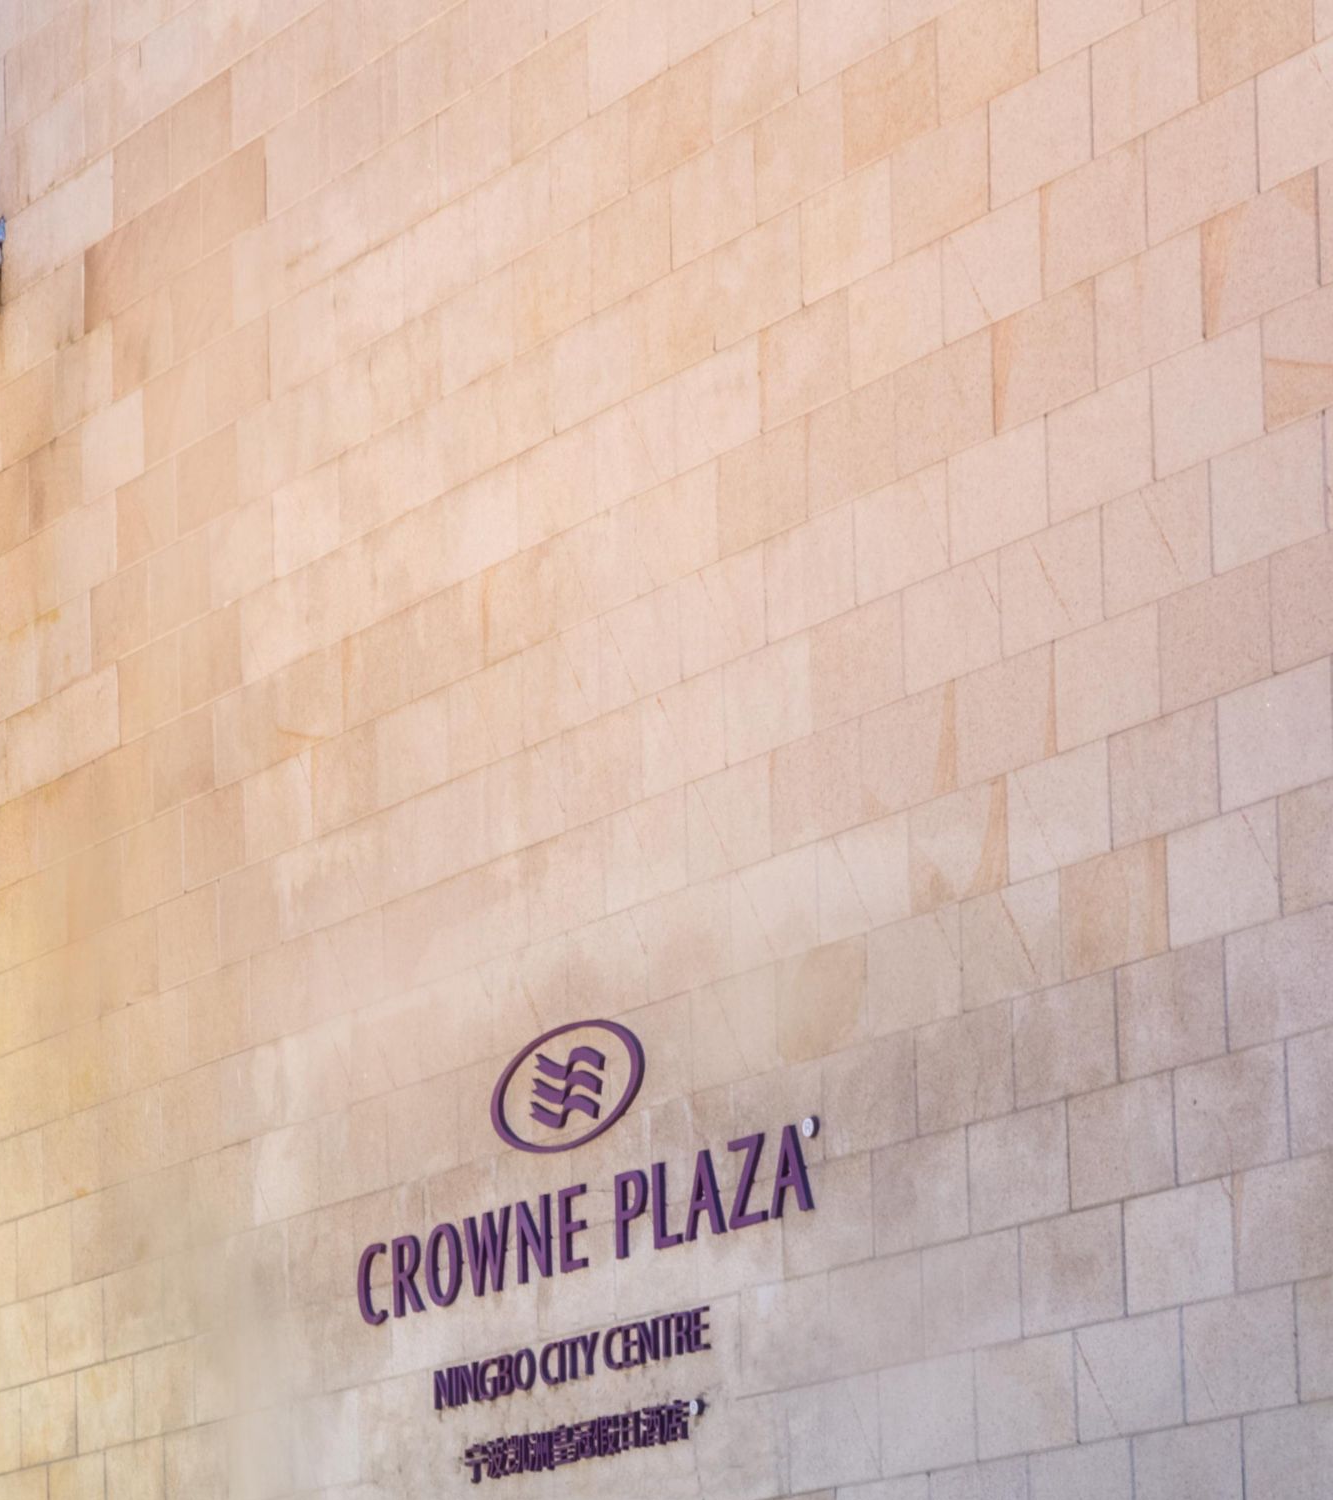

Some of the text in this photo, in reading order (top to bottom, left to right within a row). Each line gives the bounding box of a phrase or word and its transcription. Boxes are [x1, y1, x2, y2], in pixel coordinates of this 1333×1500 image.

[357, 1183, 589, 1325] CROWNE
[433, 1306, 712, 1410] NINGBO CITY CENTRE
